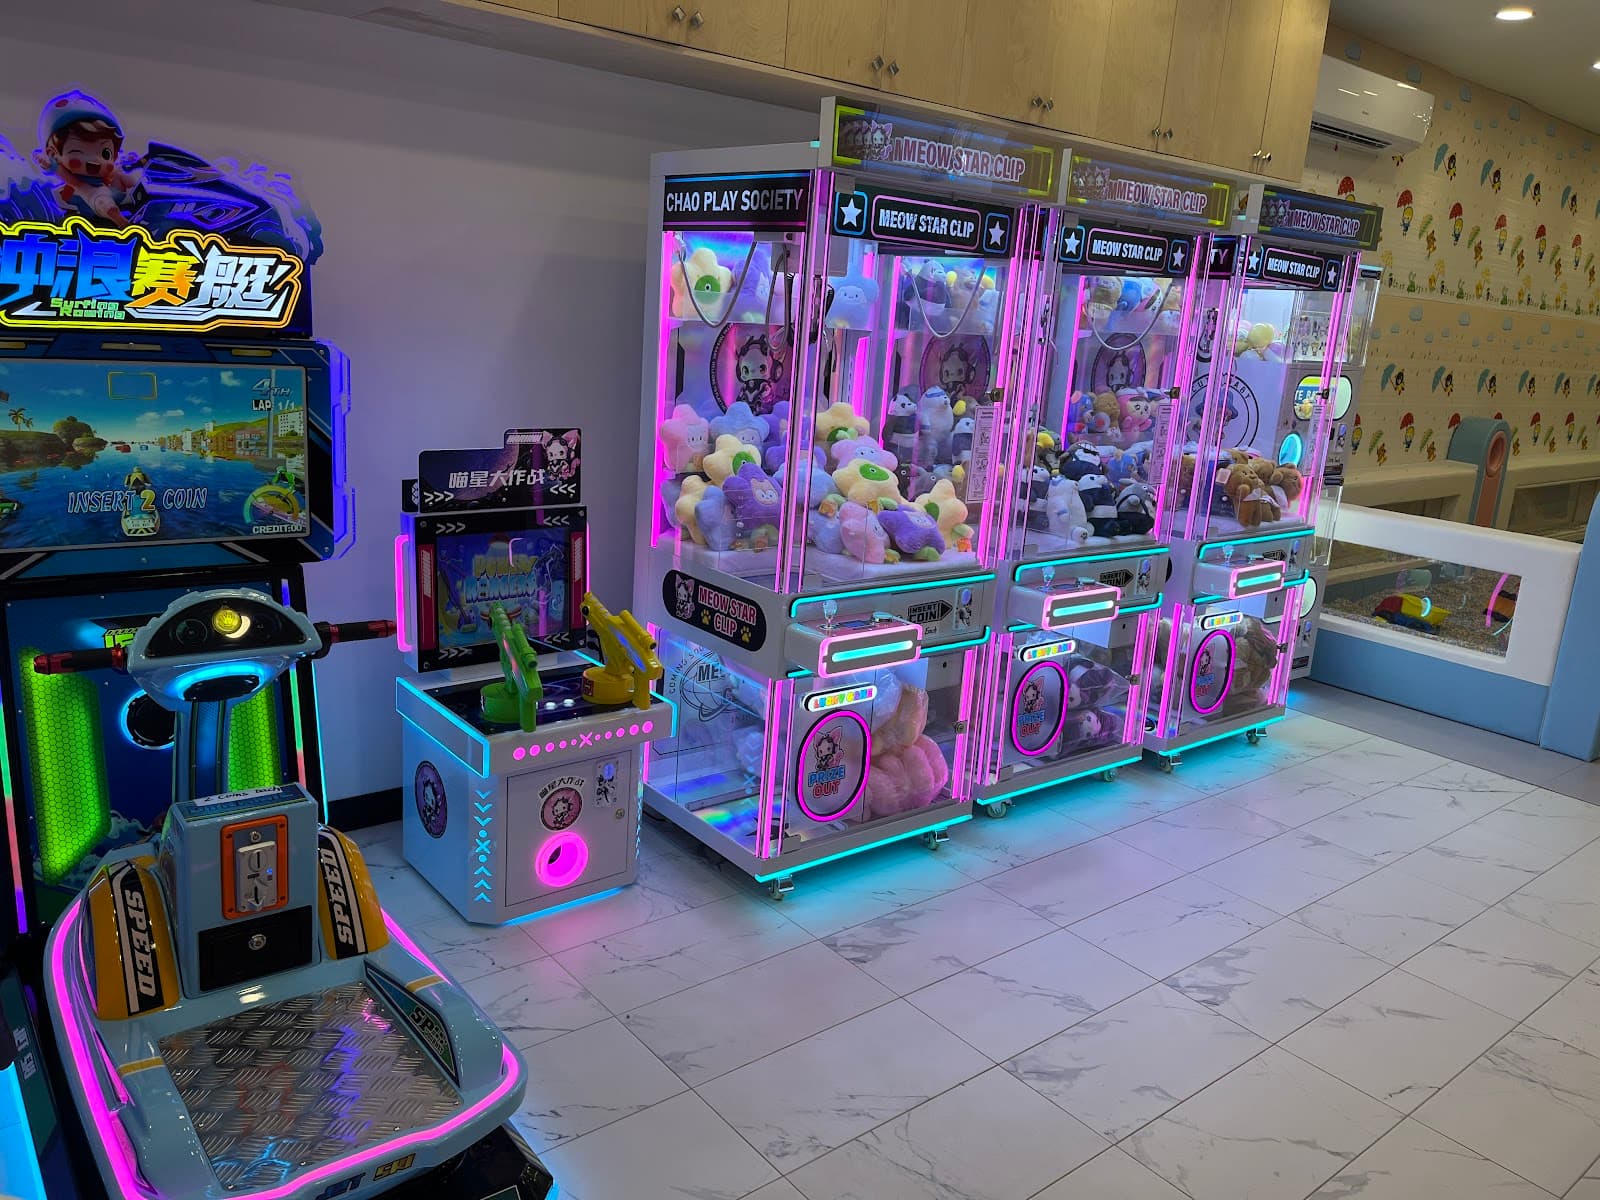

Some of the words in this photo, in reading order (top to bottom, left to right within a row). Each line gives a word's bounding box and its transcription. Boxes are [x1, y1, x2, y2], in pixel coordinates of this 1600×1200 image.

[903, 136, 951, 169] MEOW
[953, 145, 991, 175] STAR
[993, 155, 1026, 182] CLIP
[666, 192, 700, 212] CHAO
[703, 190, 738, 212] PLAY
[740, 188, 803, 211] SOCIETY
[1117, 179, 1153, 205] MEOW
[1153, 186, 1181, 210] STAR
[1182, 191, 1207, 214] CLIP
[879, 208, 918, 231] MEOW
[919, 215, 948, 235] STAR
[949, 219, 975, 238] CLIP
[1294, 208, 1320, 231] MEOW
[1320, 214, 1341, 236] STAR
[1341, 217, 1360, 237] CLIP
[1092, 239, 1122, 257] MEOW
[1122, 243, 1144, 259] STAR
[1144, 246, 1163, 262] CLIP
[1267, 257, 1289, 273] MEOW
[1289, 261, 1305, 277] STAR
[1305, 263, 1320, 279] CLIP
[252, 399, 272, 411] LAP
[448, 469, 546, 489] 喵星大作战
[68, 490, 136, 513] INSERT
[140, 489, 155, 510] 2
[162, 487, 208, 510] COIN
[698, 585, 730, 615] MEOW
[730, 598, 757, 626] STAR
[910, 603, 937, 614] INSERT
[910, 610, 937, 623] COIN
[714, 612, 738, 637] CLIP
[808, 765, 846, 787] PRIZE
[813, 780, 841, 798] OUT
[320, 847, 354, 945] SPEED
[125, 889, 157, 998] SPEED
